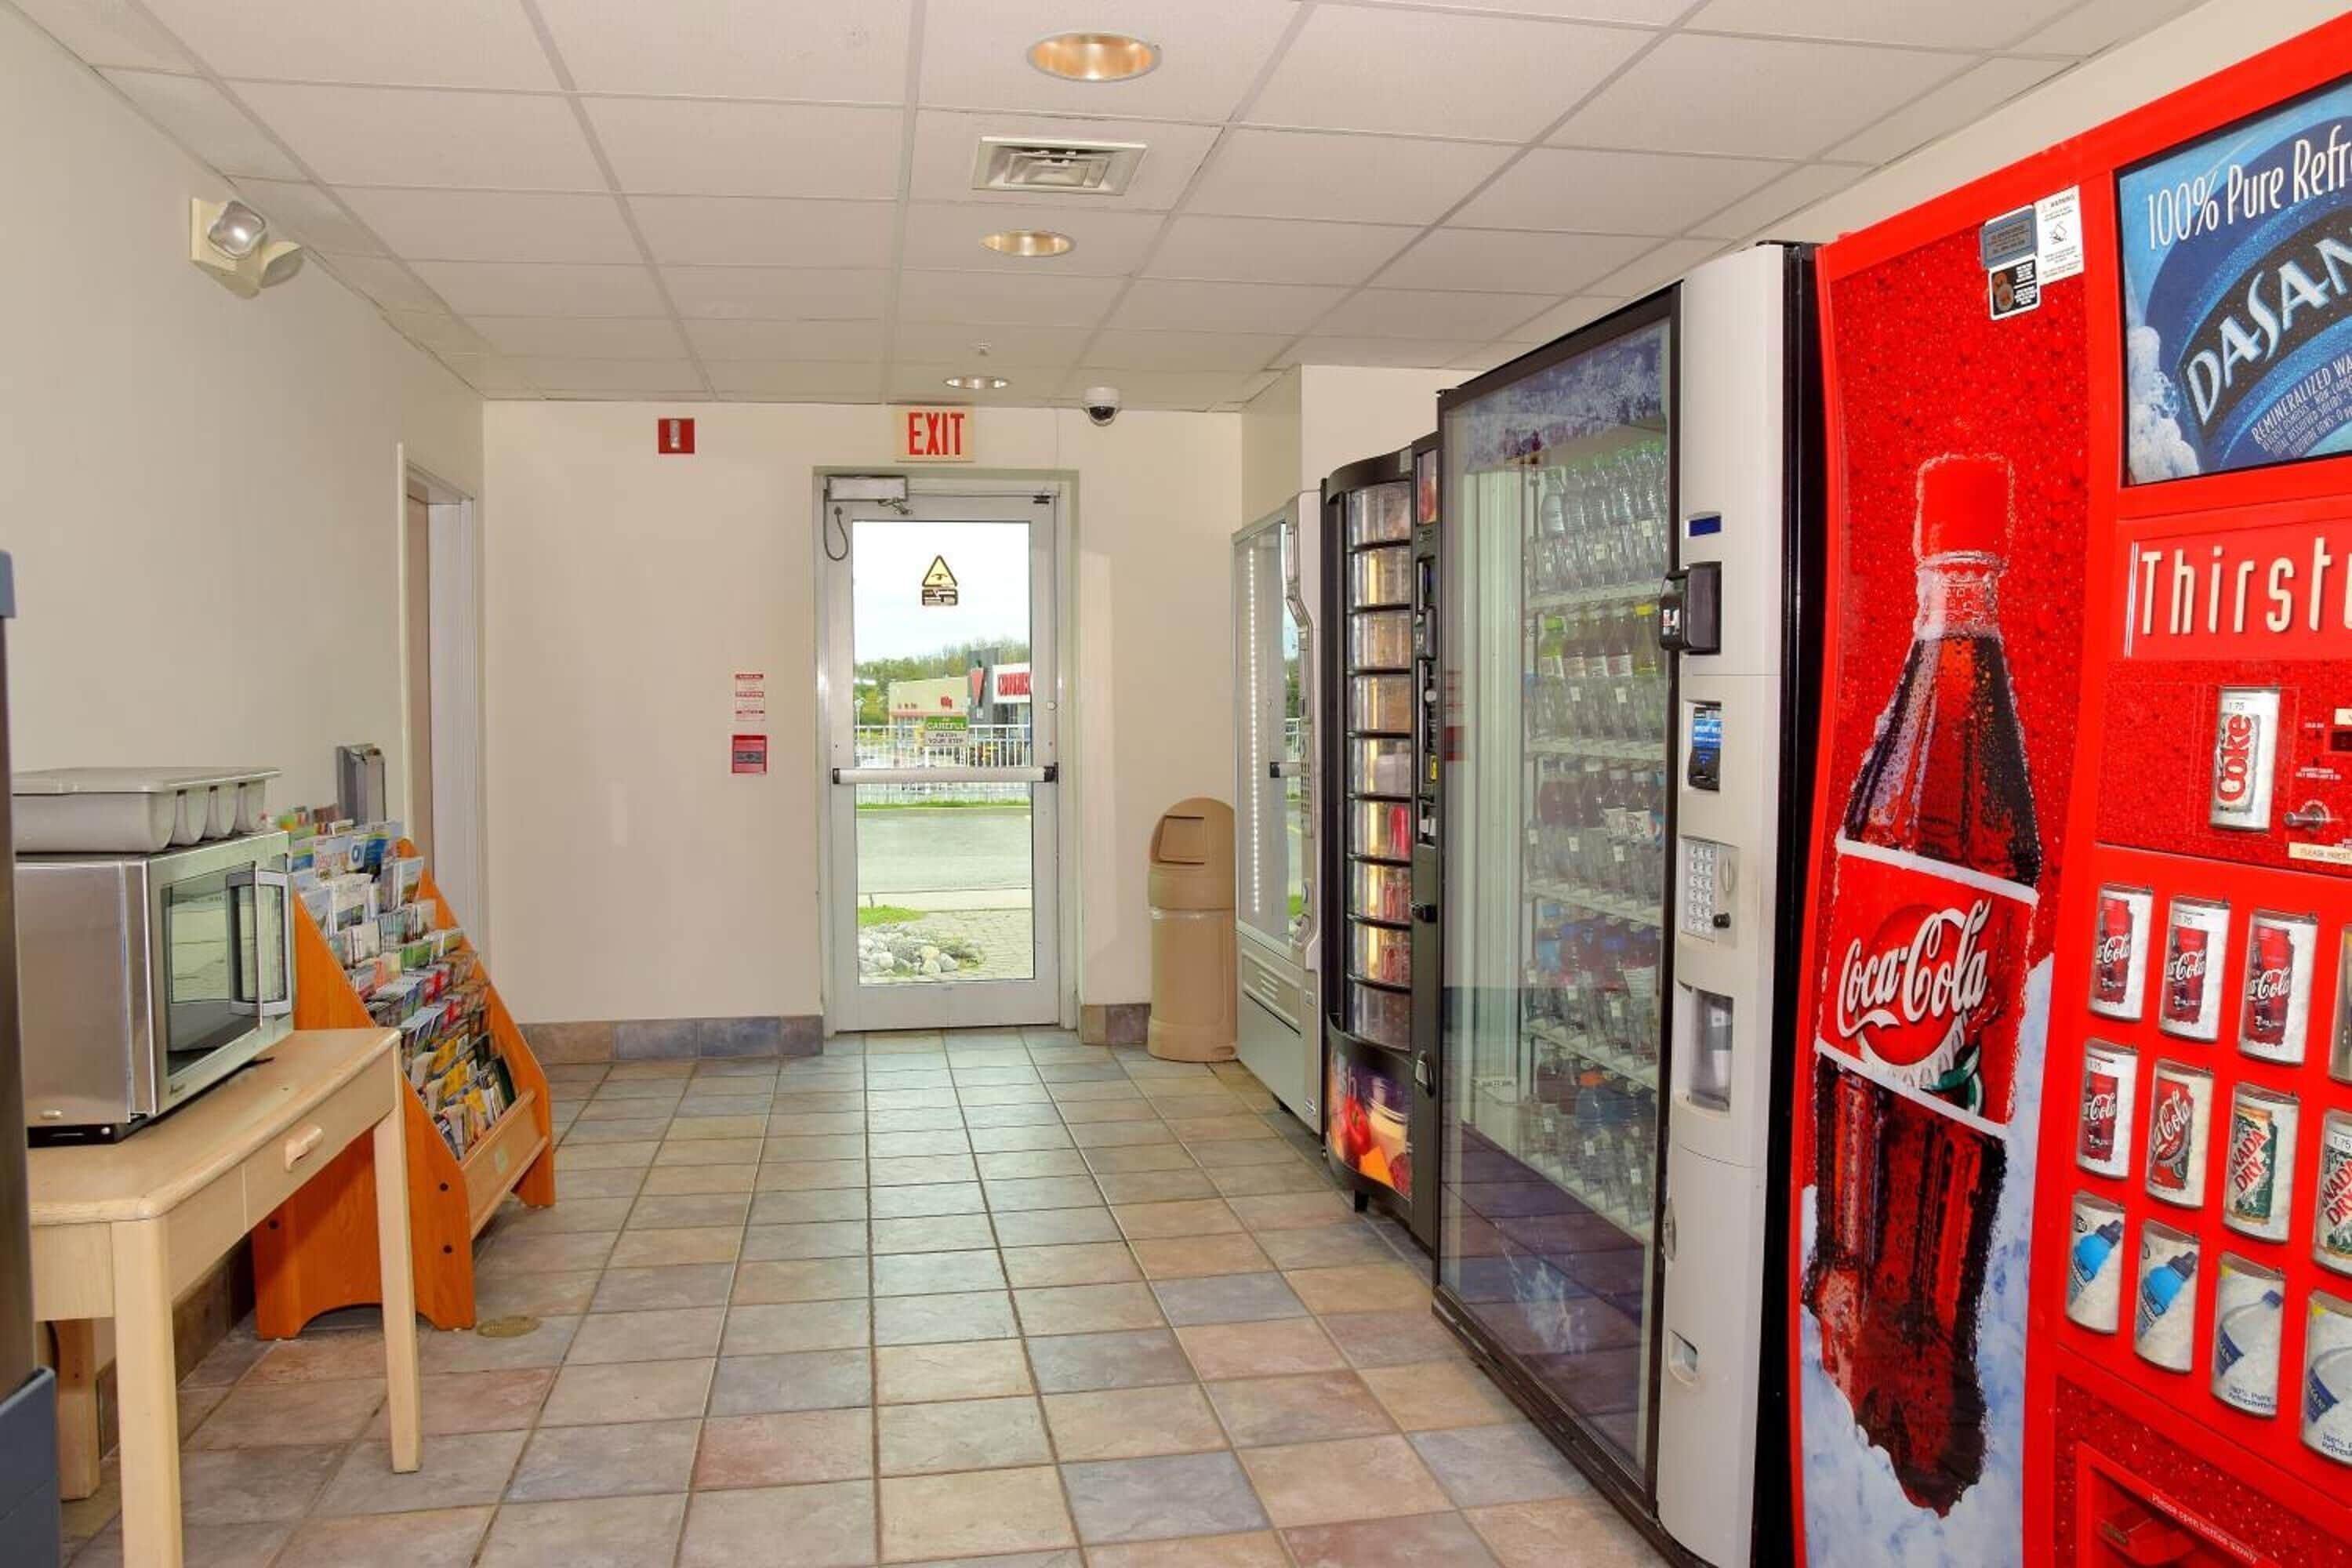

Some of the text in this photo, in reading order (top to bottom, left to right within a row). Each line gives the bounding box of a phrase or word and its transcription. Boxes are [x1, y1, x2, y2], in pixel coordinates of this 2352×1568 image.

[2148, 125, 2352, 251] 100% Pure Refr
[908, 412, 965, 456] EXIT
[2251, 367, 2332, 445] REMINERALIZED
[2141, 536, 2352, 635] Thirst
[927, 721, 965, 730] CAREFUL
[2216, 713, 2252, 802] Coke
[1837, 897, 1992, 1038] Coca-Cola
[2232, 1128, 2267, 1171] NADA
[2235, 1156, 2266, 1193] DRY
